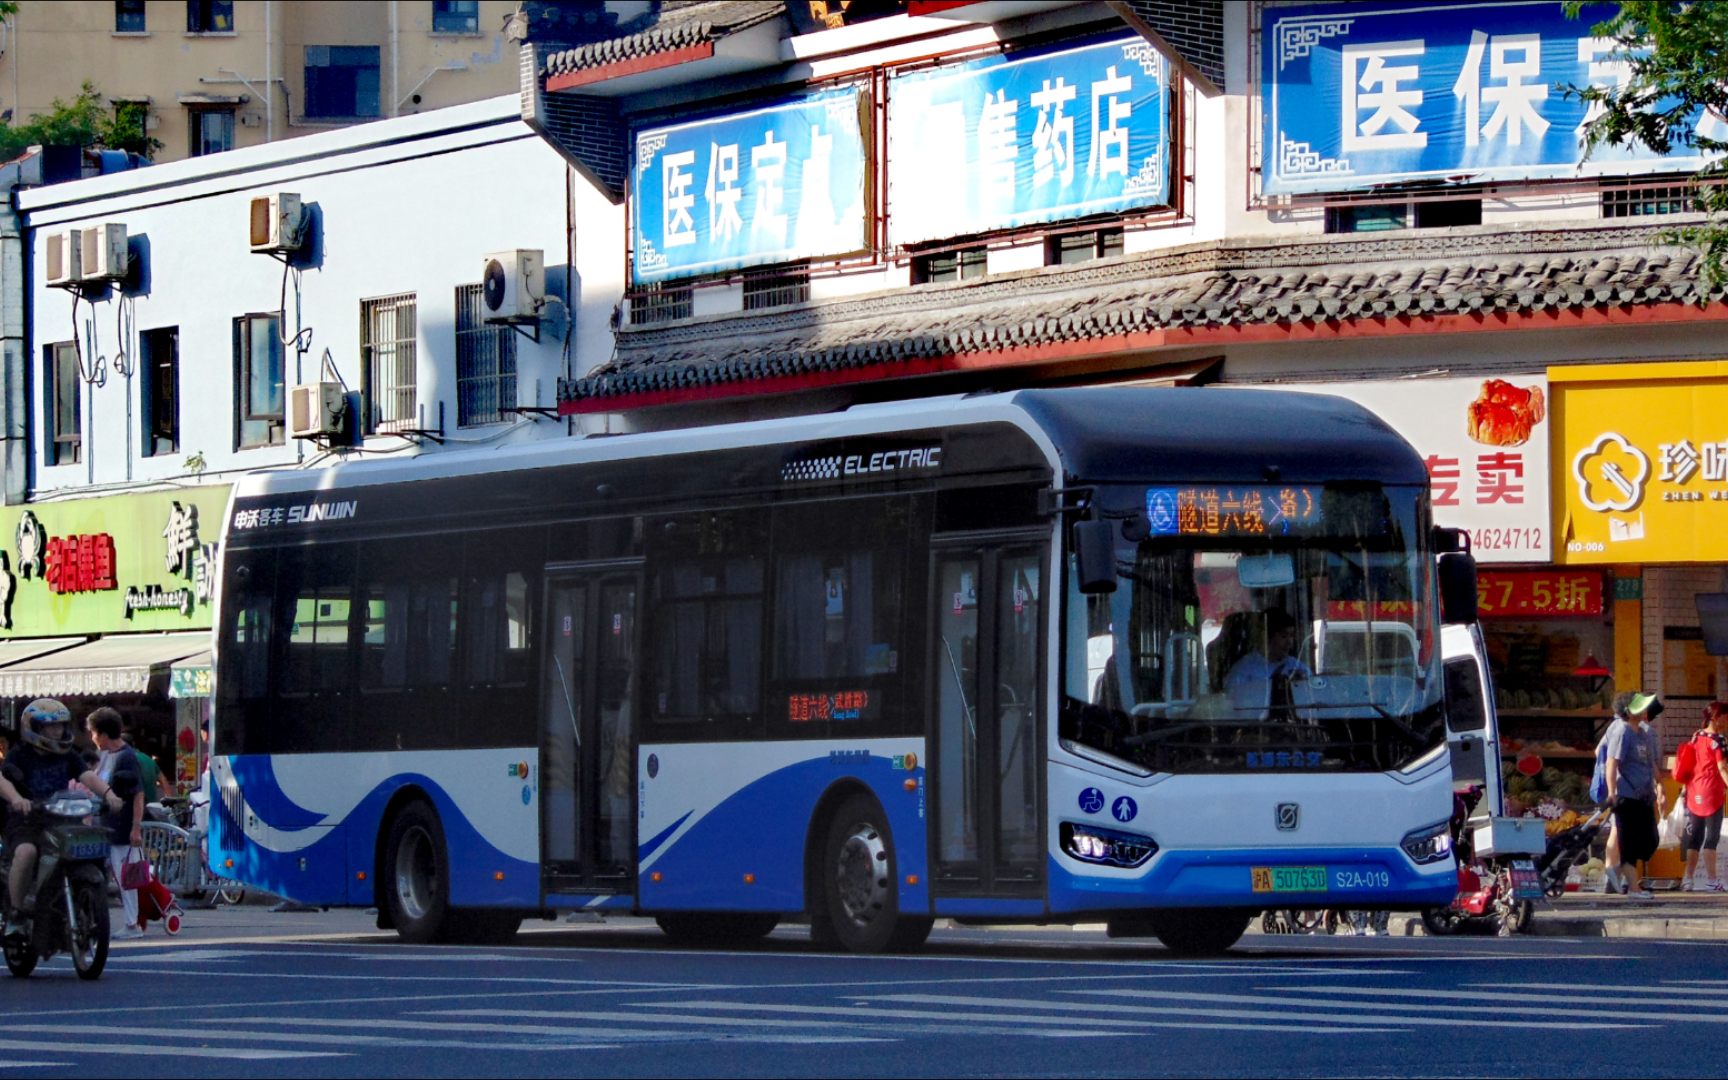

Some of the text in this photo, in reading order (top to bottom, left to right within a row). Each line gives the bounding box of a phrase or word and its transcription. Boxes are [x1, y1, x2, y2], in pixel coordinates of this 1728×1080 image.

[926, 66, 1132, 210] 售药店
[844, 447, 942, 475] ELECTRIC
[1424, 452, 1524, 506] 专卖
[1662, 491, 1700, 501] ZHEN
[234, 501, 357, 529] 申沃客车 SUNWIN
[1178, 488, 1264, 534] 隧道六线
[1567, 542, 1605, 552] NO-006
[124, 585, 191, 618] fresh-honesty
[789, 693, 828, 721] 隧道六线
[1336, 871, 1389, 888] S2A-019
